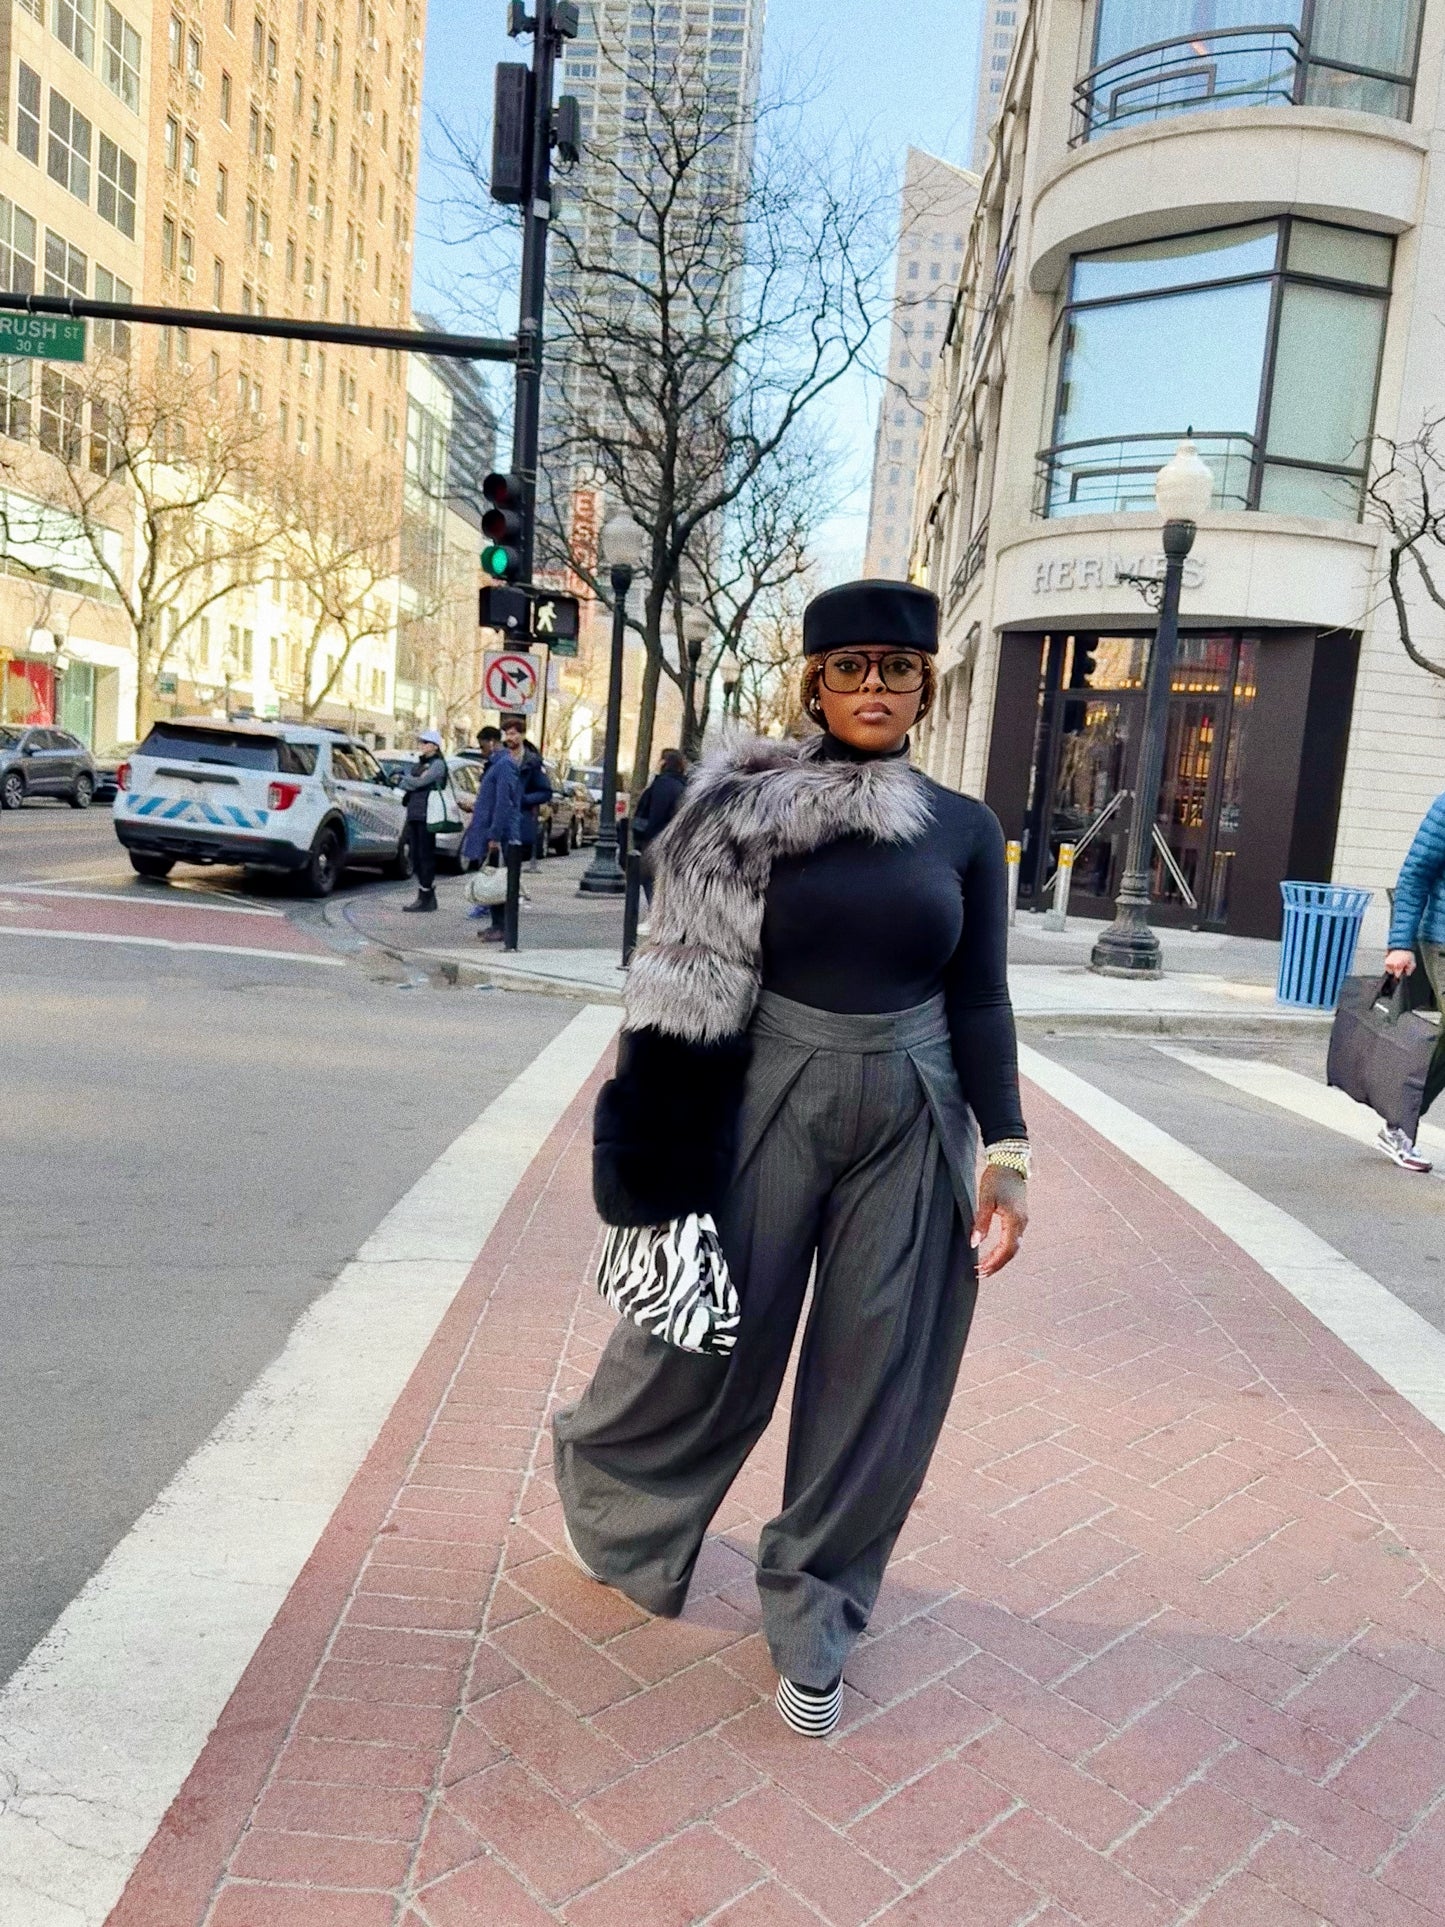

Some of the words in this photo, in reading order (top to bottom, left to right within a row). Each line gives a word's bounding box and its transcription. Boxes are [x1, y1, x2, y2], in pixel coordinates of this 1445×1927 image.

[0, 317, 57, 340] RUSH
[63, 326, 80, 339] ST
[16, 339, 32, 352] 30
[37, 341, 46, 354] E
